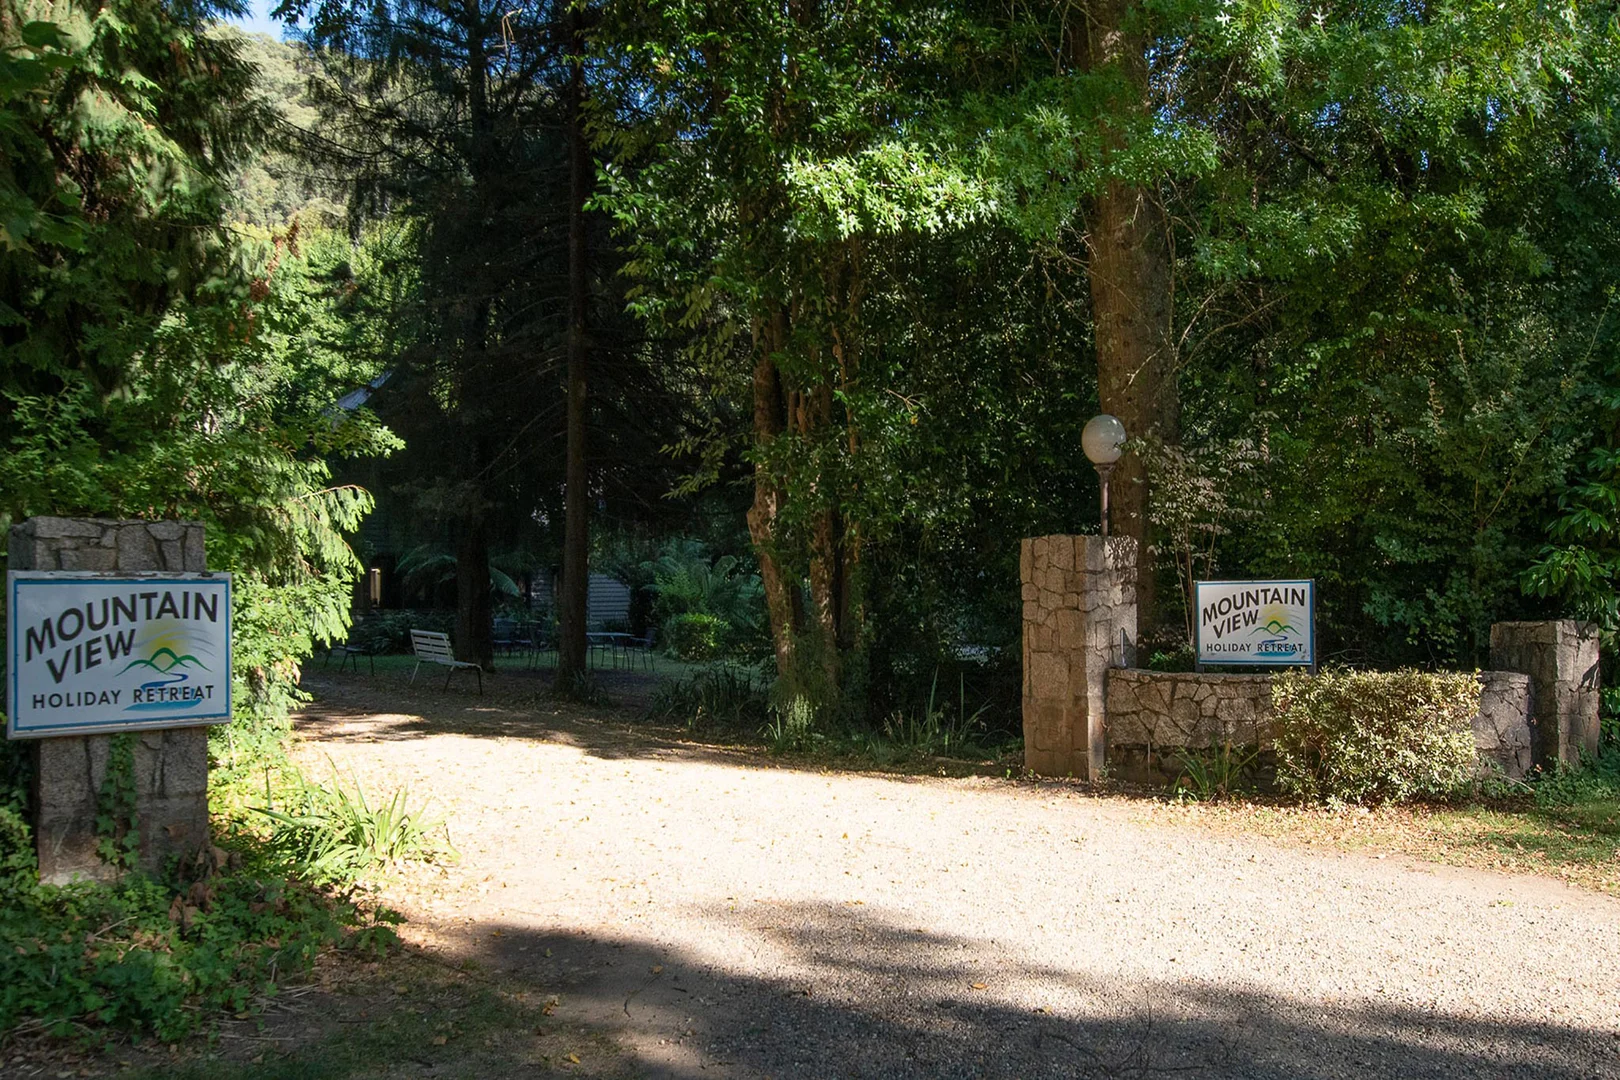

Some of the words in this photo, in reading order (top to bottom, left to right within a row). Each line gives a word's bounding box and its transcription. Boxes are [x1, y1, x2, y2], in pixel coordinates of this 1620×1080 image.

[1202, 587, 1305, 626] MOUNTAIN
[25, 591, 218, 663] MOUNTAIN
[1213, 609, 1259, 639] VIEW
[46, 628, 136, 684] VIEW
[1206, 643, 1252, 652] HOLIDAY
[1257, 643, 1304, 652] RETREAT
[32, 689, 122, 709] HOLIDAY
[133, 685, 214, 703] RETREAT
